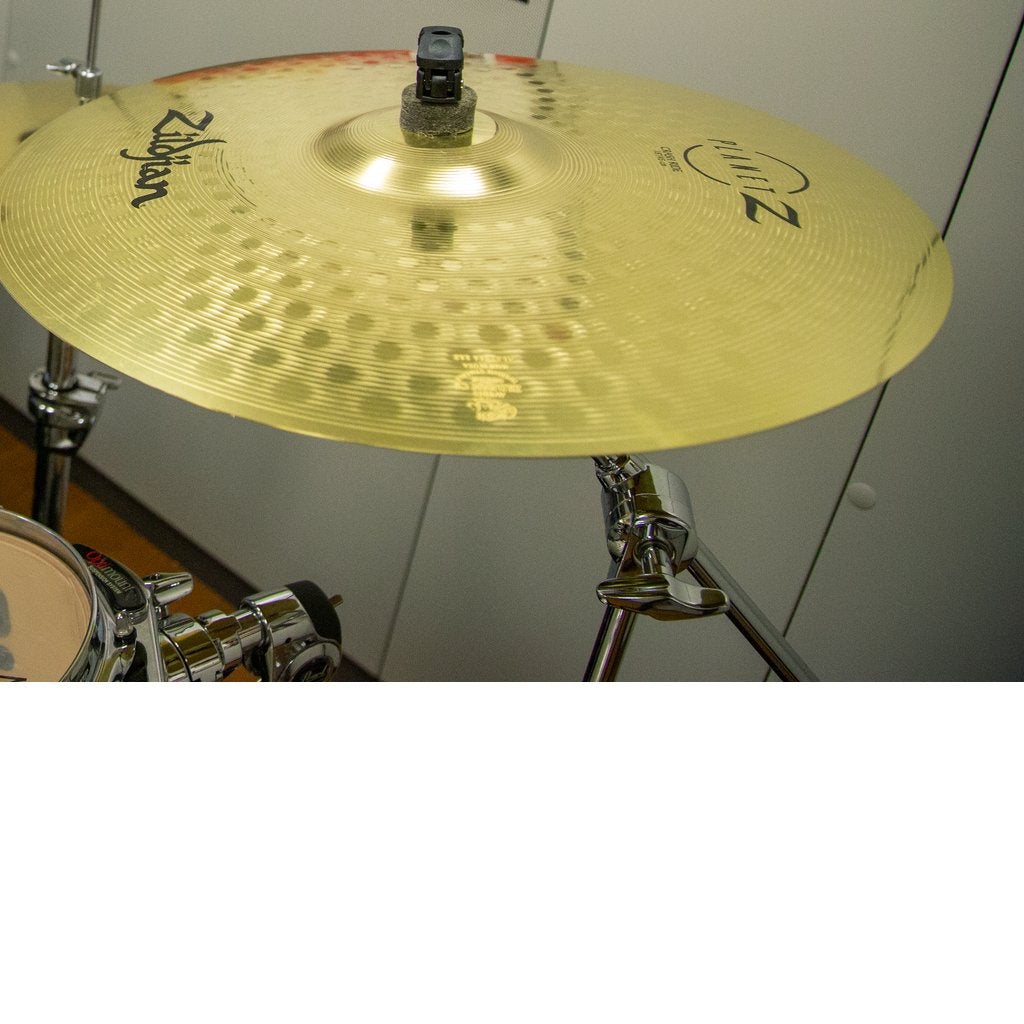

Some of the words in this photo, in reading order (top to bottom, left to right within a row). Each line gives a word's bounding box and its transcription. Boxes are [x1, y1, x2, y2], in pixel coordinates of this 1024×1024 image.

[119, 108, 227, 209] Zildjian
[707, 138, 776, 194] PLANET
[739, 191, 802, 229] Z
